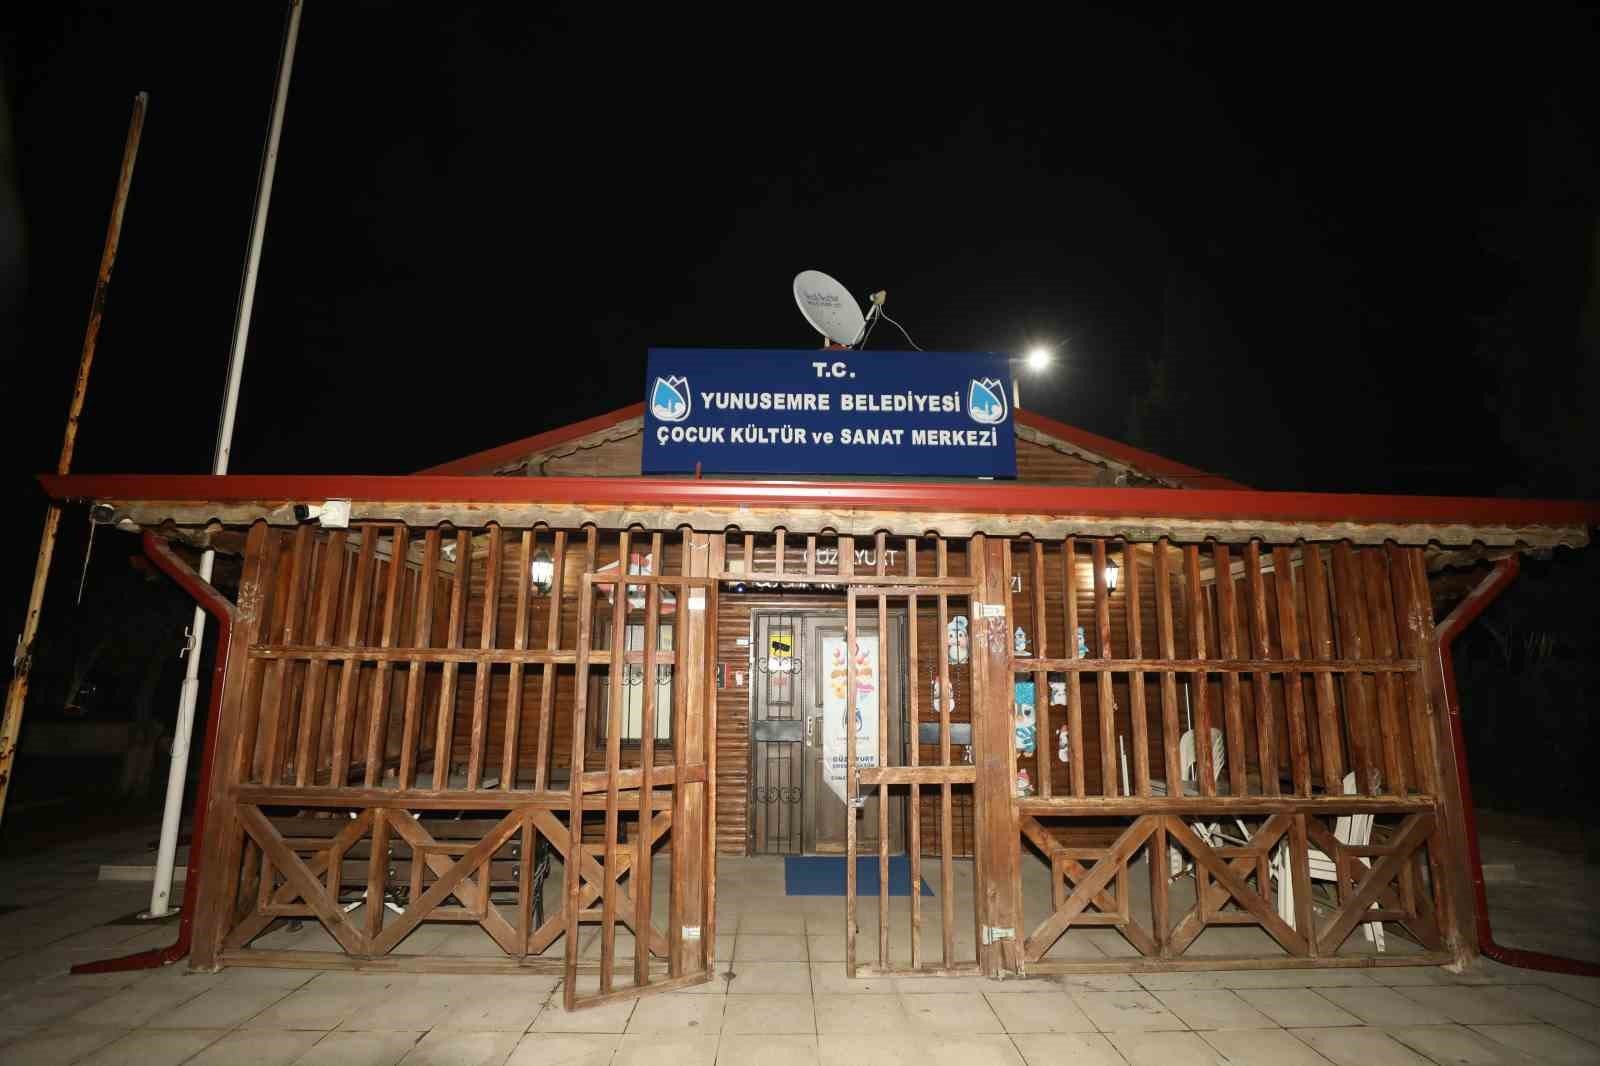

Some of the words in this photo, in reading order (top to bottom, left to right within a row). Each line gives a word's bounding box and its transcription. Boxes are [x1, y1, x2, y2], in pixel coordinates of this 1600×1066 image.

[813, 362, 855, 378] T.C.
[701, 392, 830, 410] YUNUSEMRE
[841, 391, 960, 412] BELEDİYESİ
[657, 426, 724, 445] ÇOCUK
[731, 424, 806, 443] KÜLTÜR
[812, 432, 833, 444] ve
[841, 429, 904, 445] SANAT
[912, 427, 997, 446] MERKEZİ
